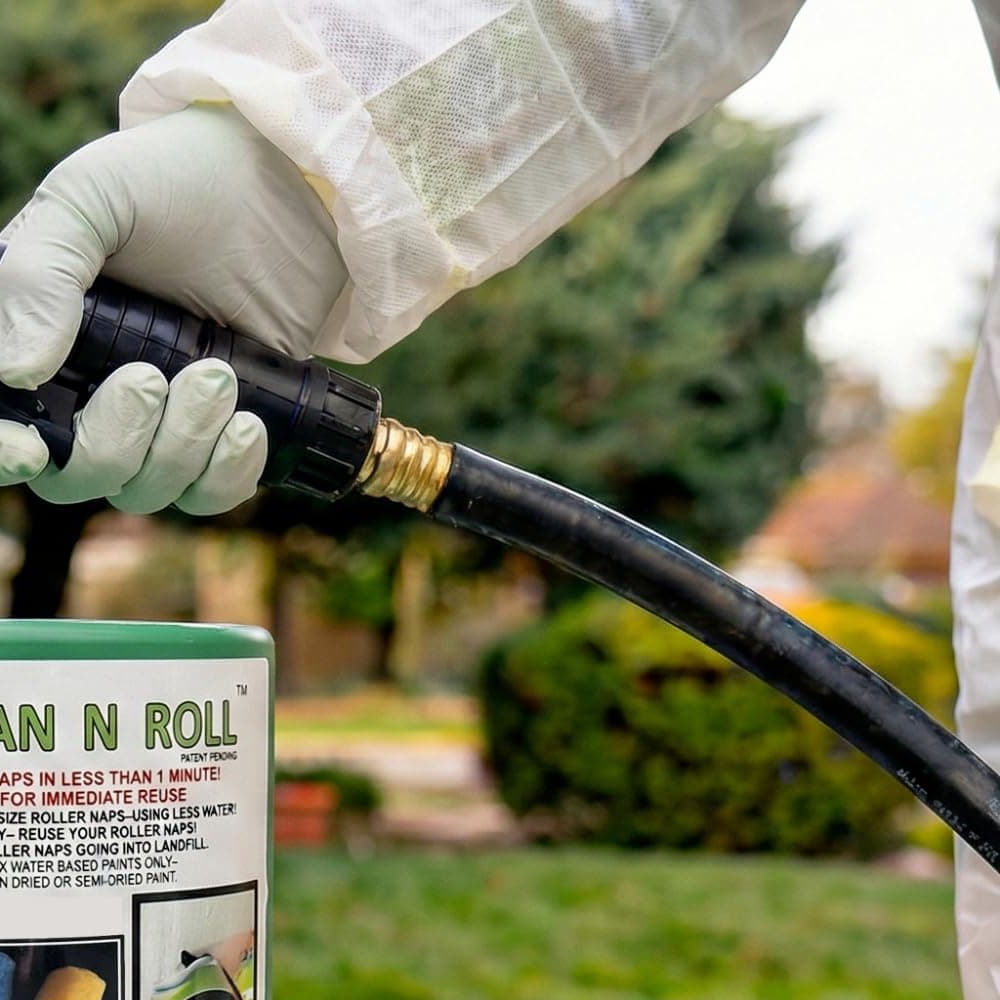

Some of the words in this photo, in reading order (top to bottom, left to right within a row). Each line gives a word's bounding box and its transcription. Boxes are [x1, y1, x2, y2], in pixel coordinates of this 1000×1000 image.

[83, 702, 118, 751] N
[146, 700, 237, 749] ROLL
[181, 753, 207, 762] PATENT
[39, 772, 55, 786] IN
[61, 771, 104, 786] LESS
[110, 770, 152, 784] THAN
[157, 770, 163, 783] 1
[169, 767, 221, 783] MINUTE!
[0, 792, 35, 806] FOR
[42, 790, 133, 806] IMMEDIATE
[138, 788, 187, 803] REUSE
[31, 811, 85, 824] ROLLER
[173, 806, 200, 820] LESS
[202, 803, 236, 817] WATER!
[19, 829, 65, 841] REUSE
[69, 827, 106, 840] YOUR
[111, 824, 160, 838] ROLLER
[164, 822, 197, 836] NAPS!
[34, 844, 72, 857] NAPS
[76, 843, 119, 856] GOING
[123, 842, 150, 855] INTO
[154, 838, 209, 853] LANDFILL.
[11, 861, 54, 873] WATER
[57, 859, 98, 872] BASED
[102, 857, 141, 871] PAINTS
[12, 876, 50, 889] DRIED
[54, 875, 71, 888] OR
[146, 871, 177, 885] PAINT.
